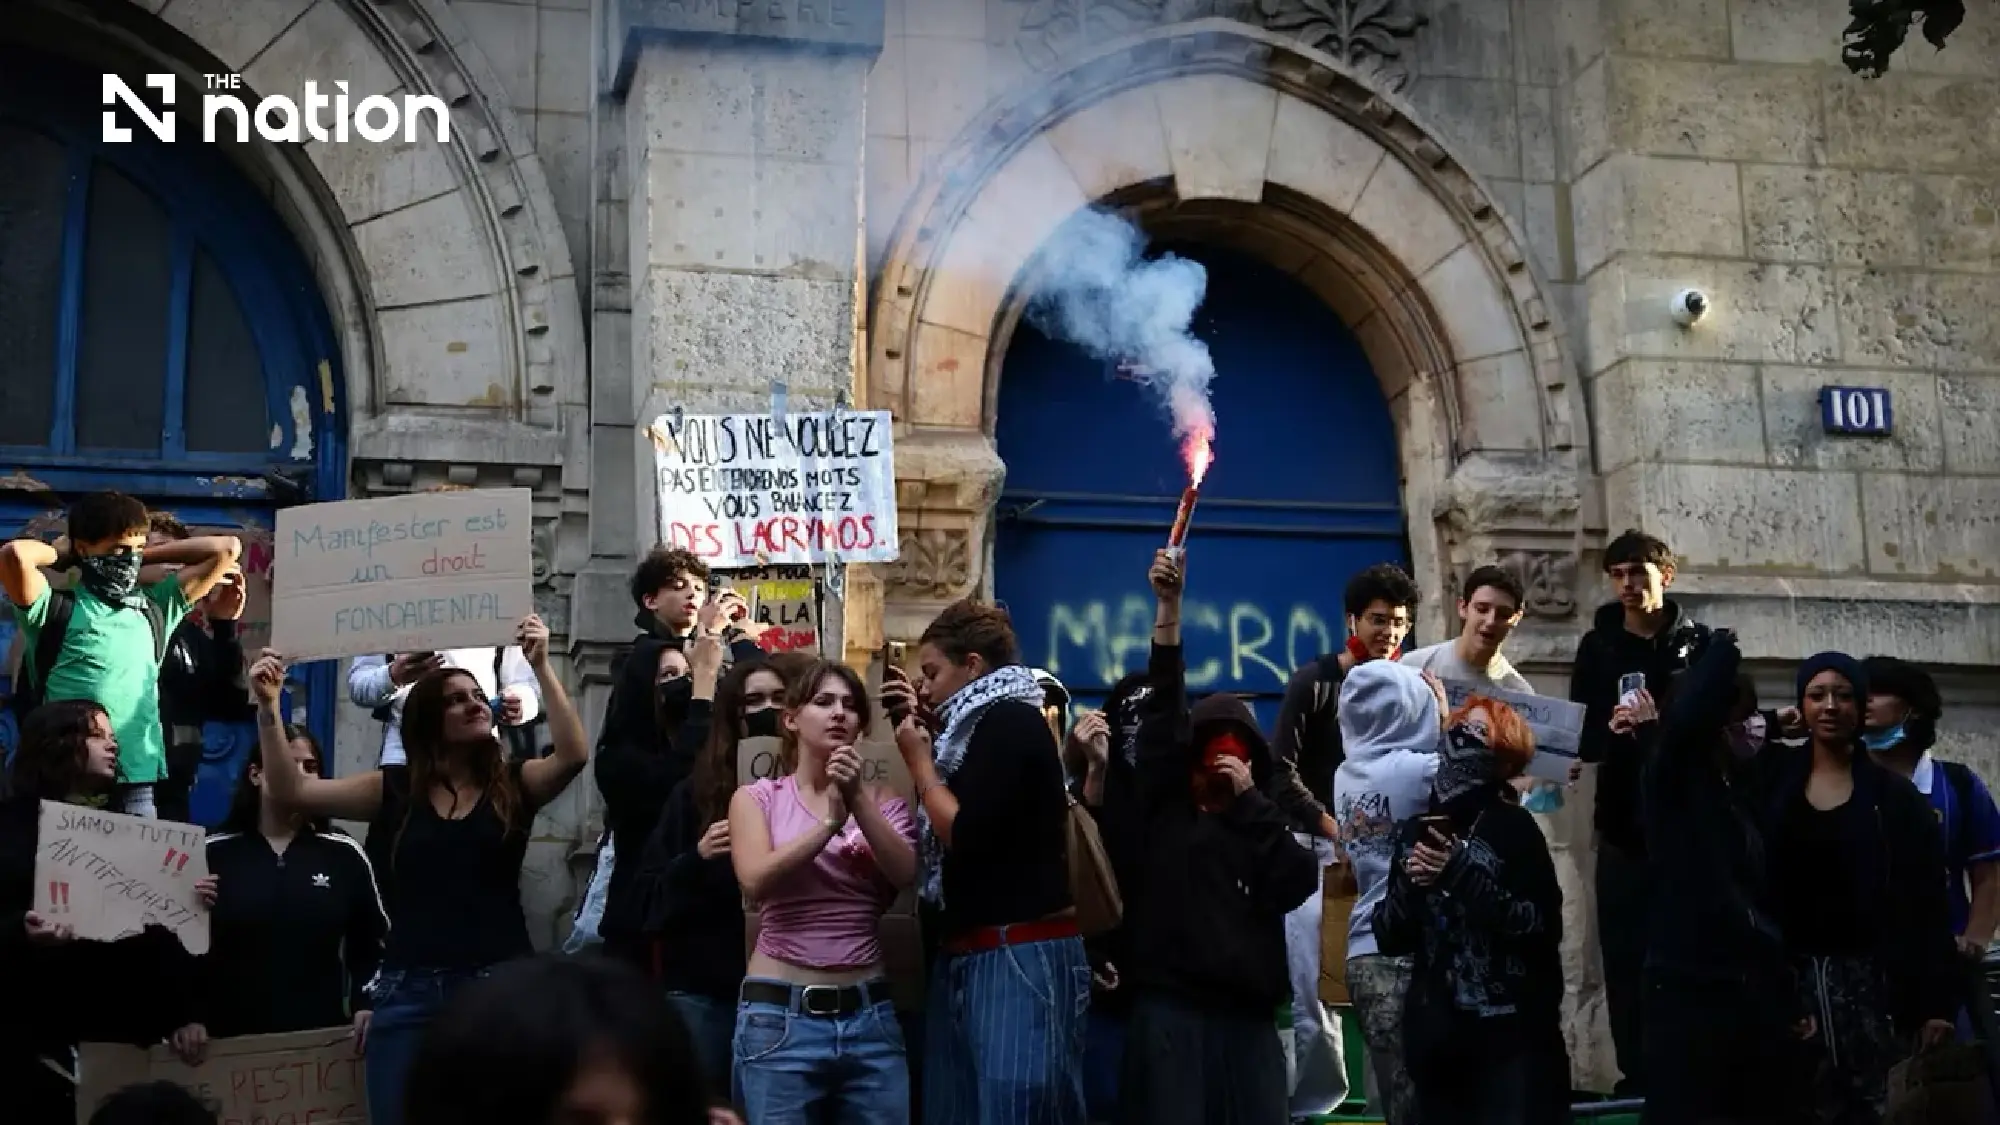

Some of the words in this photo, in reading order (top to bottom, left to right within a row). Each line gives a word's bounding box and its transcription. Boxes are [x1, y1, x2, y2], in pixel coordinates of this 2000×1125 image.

[1831, 390, 1884, 429] 101
[666, 416, 737, 465] VOUS
[745, 418, 775, 460] NE
[784, 416, 879, 458] VOULEZ
[660, 466, 696, 494] PAS
[805, 467, 861, 489] MOTS
[702, 494, 760, 520] VOUS
[293, 514, 451, 557] Manifester
[464, 508, 508, 532] est
[671, 522, 723, 557] DES
[350, 564, 393, 583] un
[421, 543, 486, 576] droit
[780, 601, 810, 624] LA
[56, 810, 115, 835] SIAMO
[136, 823, 199, 848] TUTTI
